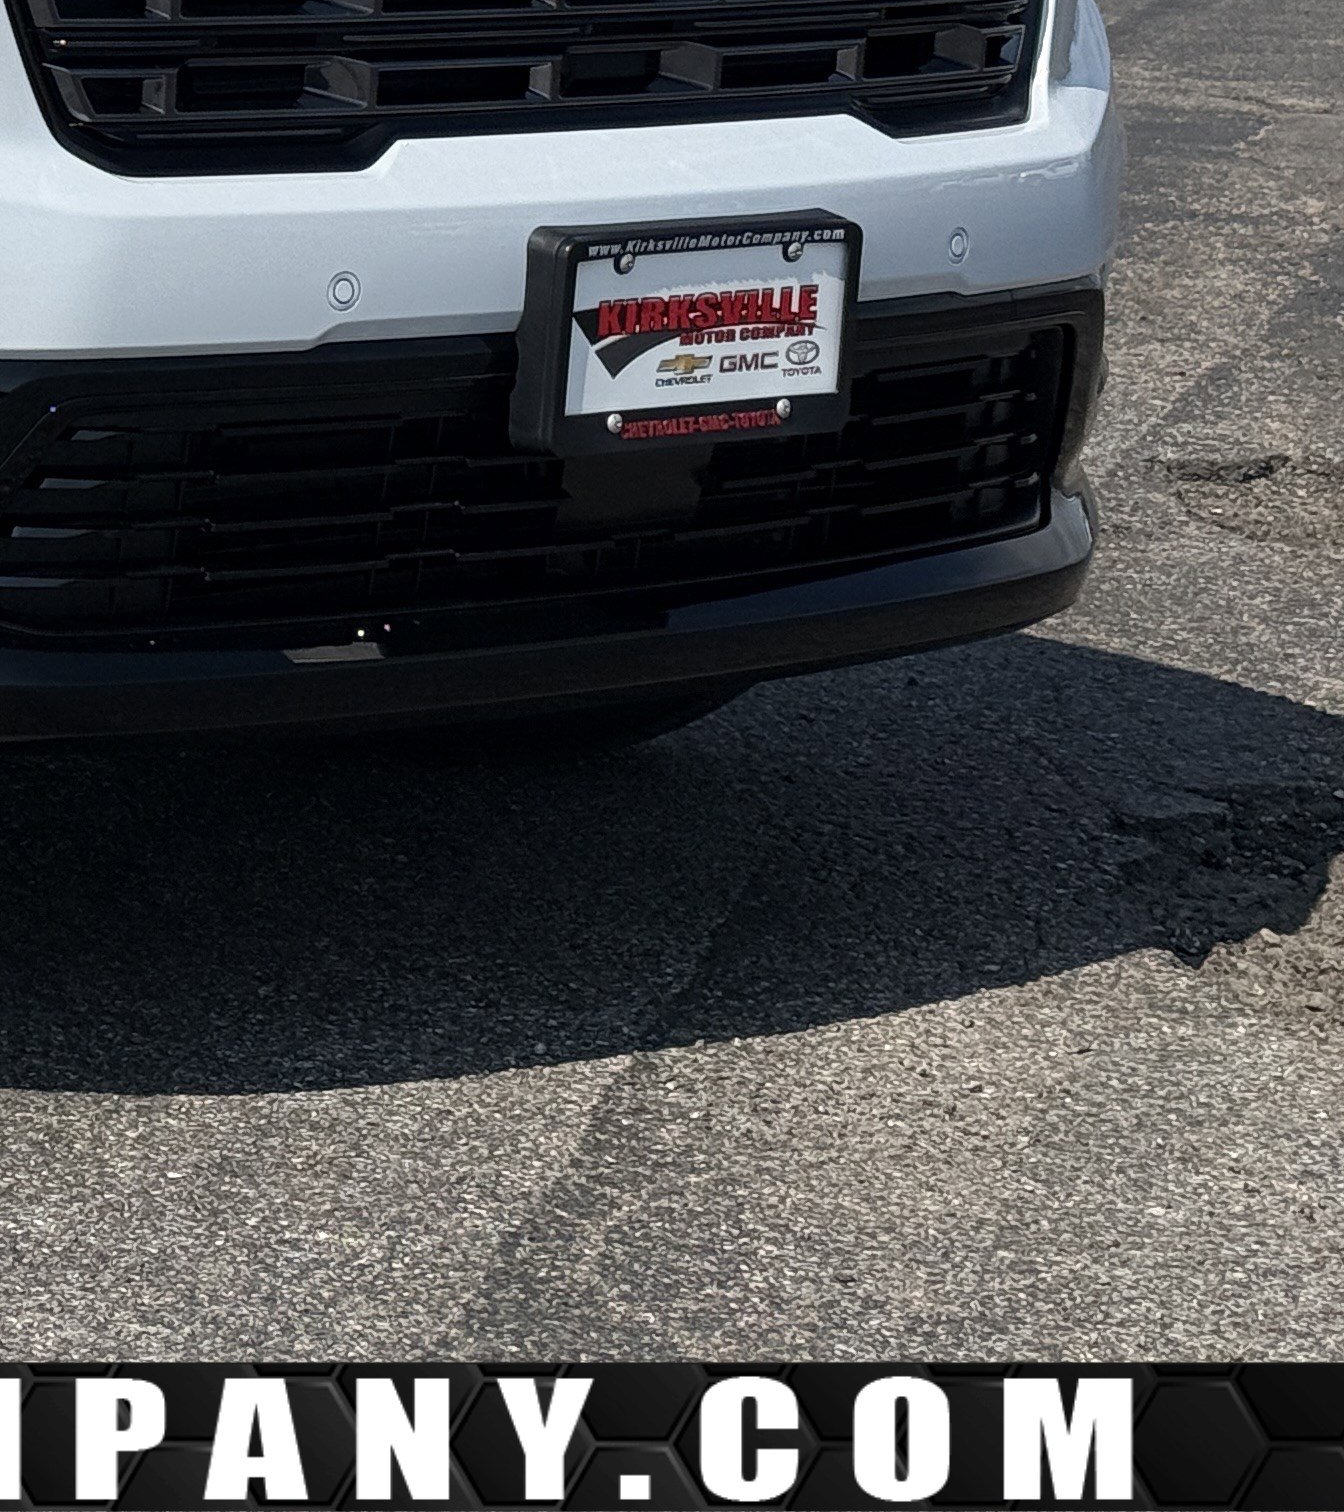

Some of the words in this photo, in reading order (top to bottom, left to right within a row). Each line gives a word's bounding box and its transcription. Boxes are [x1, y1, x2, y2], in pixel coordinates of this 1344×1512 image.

[588, 228, 845, 257] www.KirksvilleMotorCompany.com
[597, 284, 819, 339] KIRKSVILLE
[678, 329, 736, 347] MOTOR
[739, 322, 814, 342] COMPANY
[719, 350, 779, 373] GMC
[781, 365, 822, 378] TOYOTA
[655, 373, 712, 388] CHEVROLET
